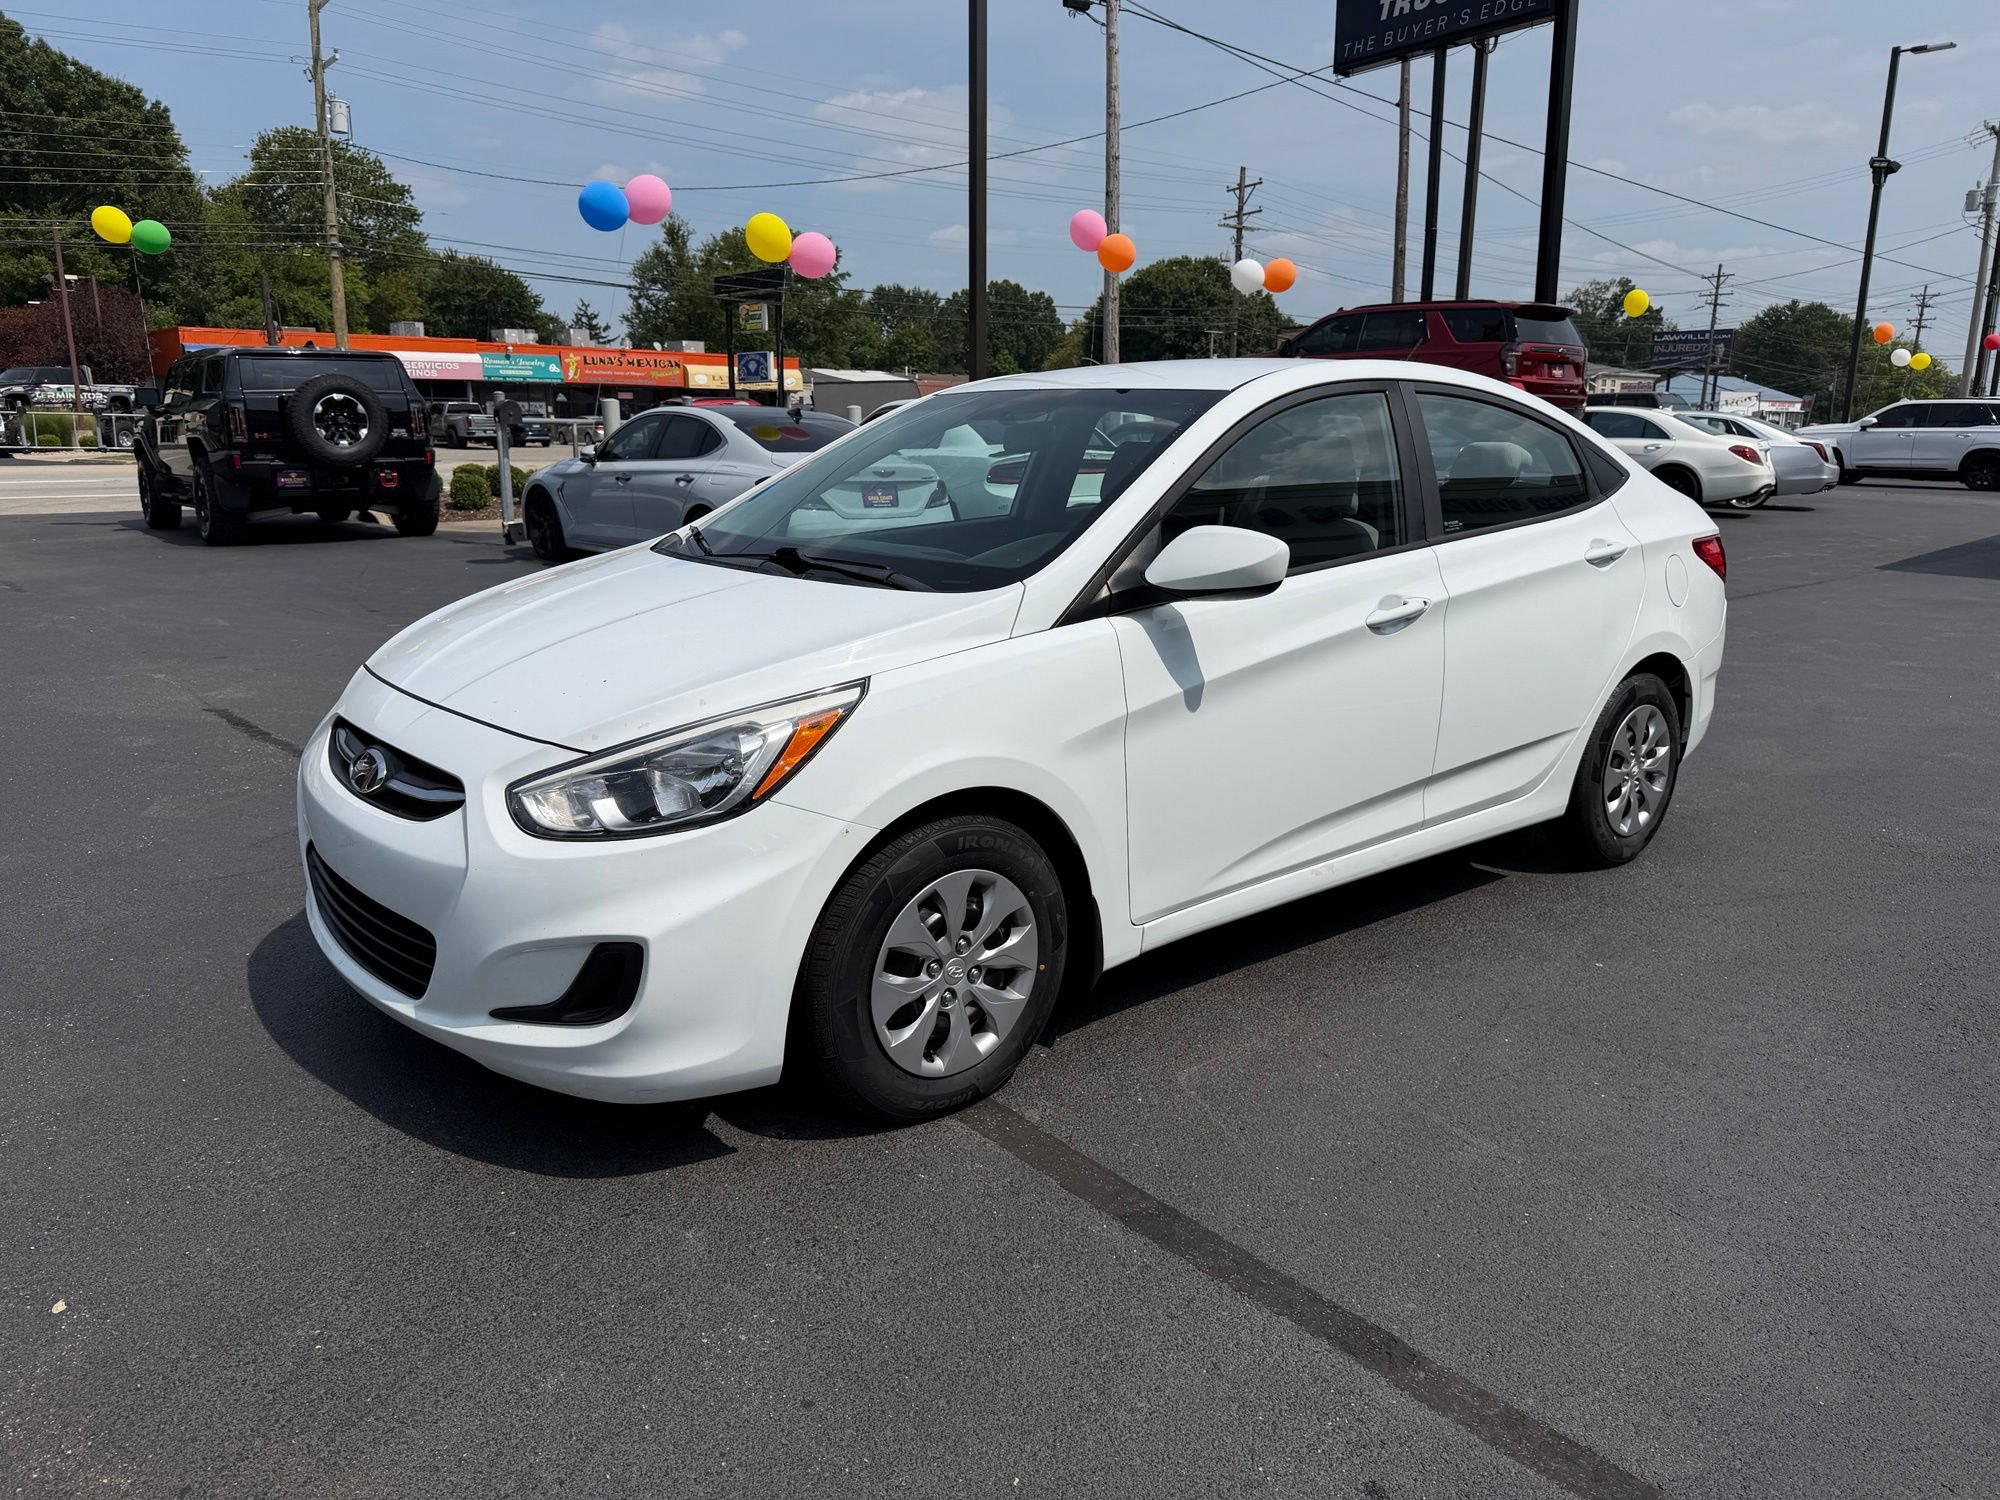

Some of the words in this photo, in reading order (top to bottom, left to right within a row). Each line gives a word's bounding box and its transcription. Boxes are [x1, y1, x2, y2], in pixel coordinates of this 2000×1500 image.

[1379, 0, 1448, 20] TRU
[1344, 36, 1376, 57] THE
[1384, 8, 1471, 47] BUYER'S
[1654, 343, 1707, 353] INJURED?
[404, 361, 460, 370] SERVICIOS
[583, 355, 623, 367] LUNA'S
[627, 359, 681, 369] MEXICAN
[34, 391, 103, 400] TERMINTOR
